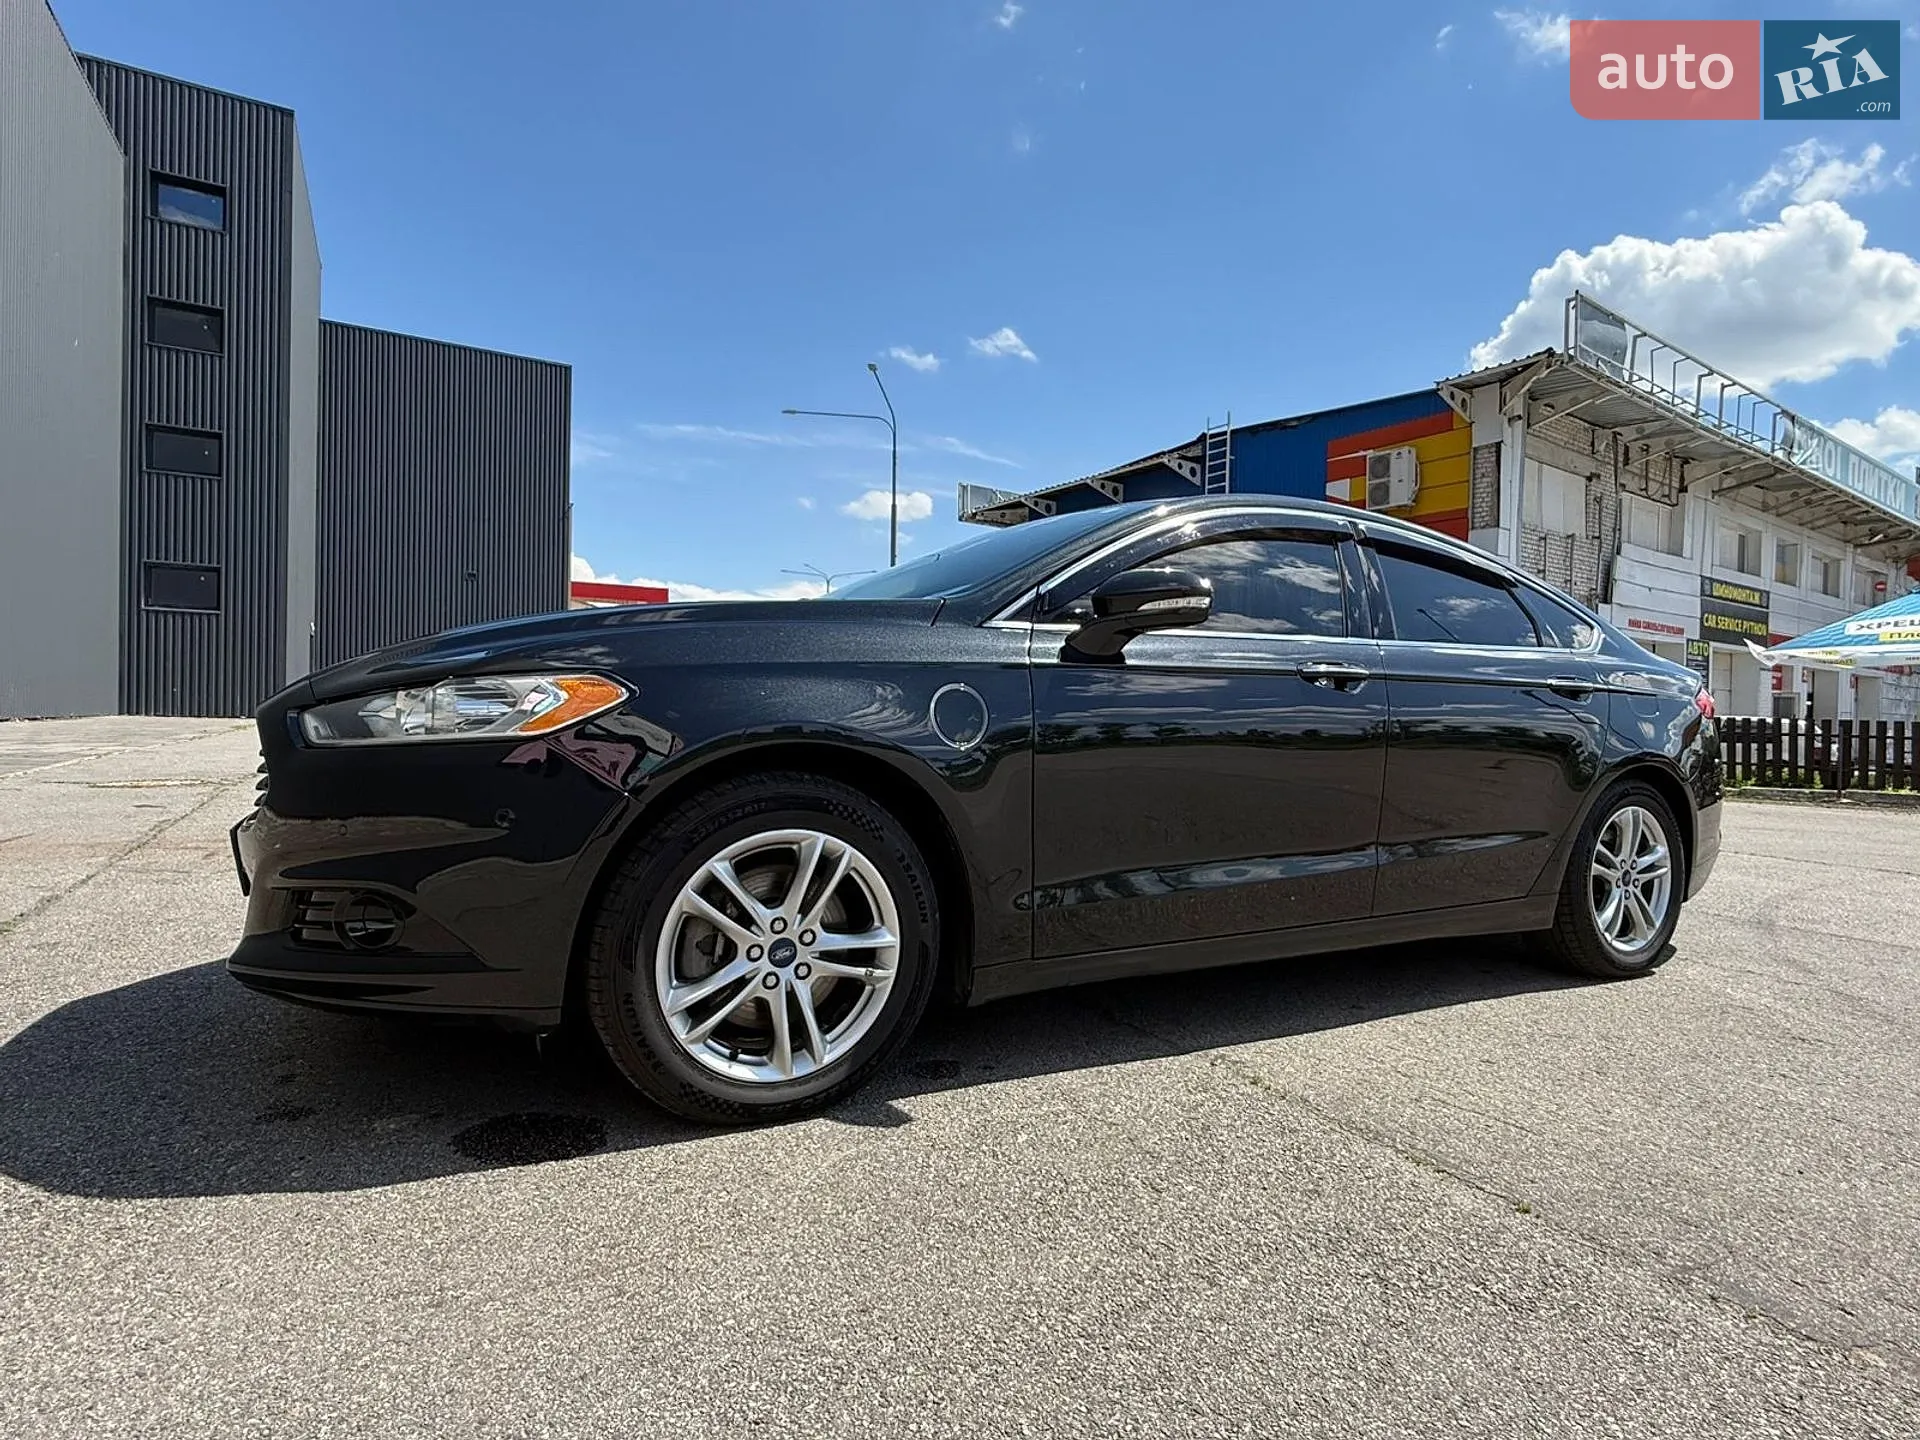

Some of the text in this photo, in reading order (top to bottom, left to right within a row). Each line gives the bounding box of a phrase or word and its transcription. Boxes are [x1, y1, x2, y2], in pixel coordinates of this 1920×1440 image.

[1703, 613, 1717, 627] CAR
[1718, 615, 1742, 632] SERVICE
[1743, 620, 1767, 636] PYTHON
[1688, 641, 1709, 657] АВТО
